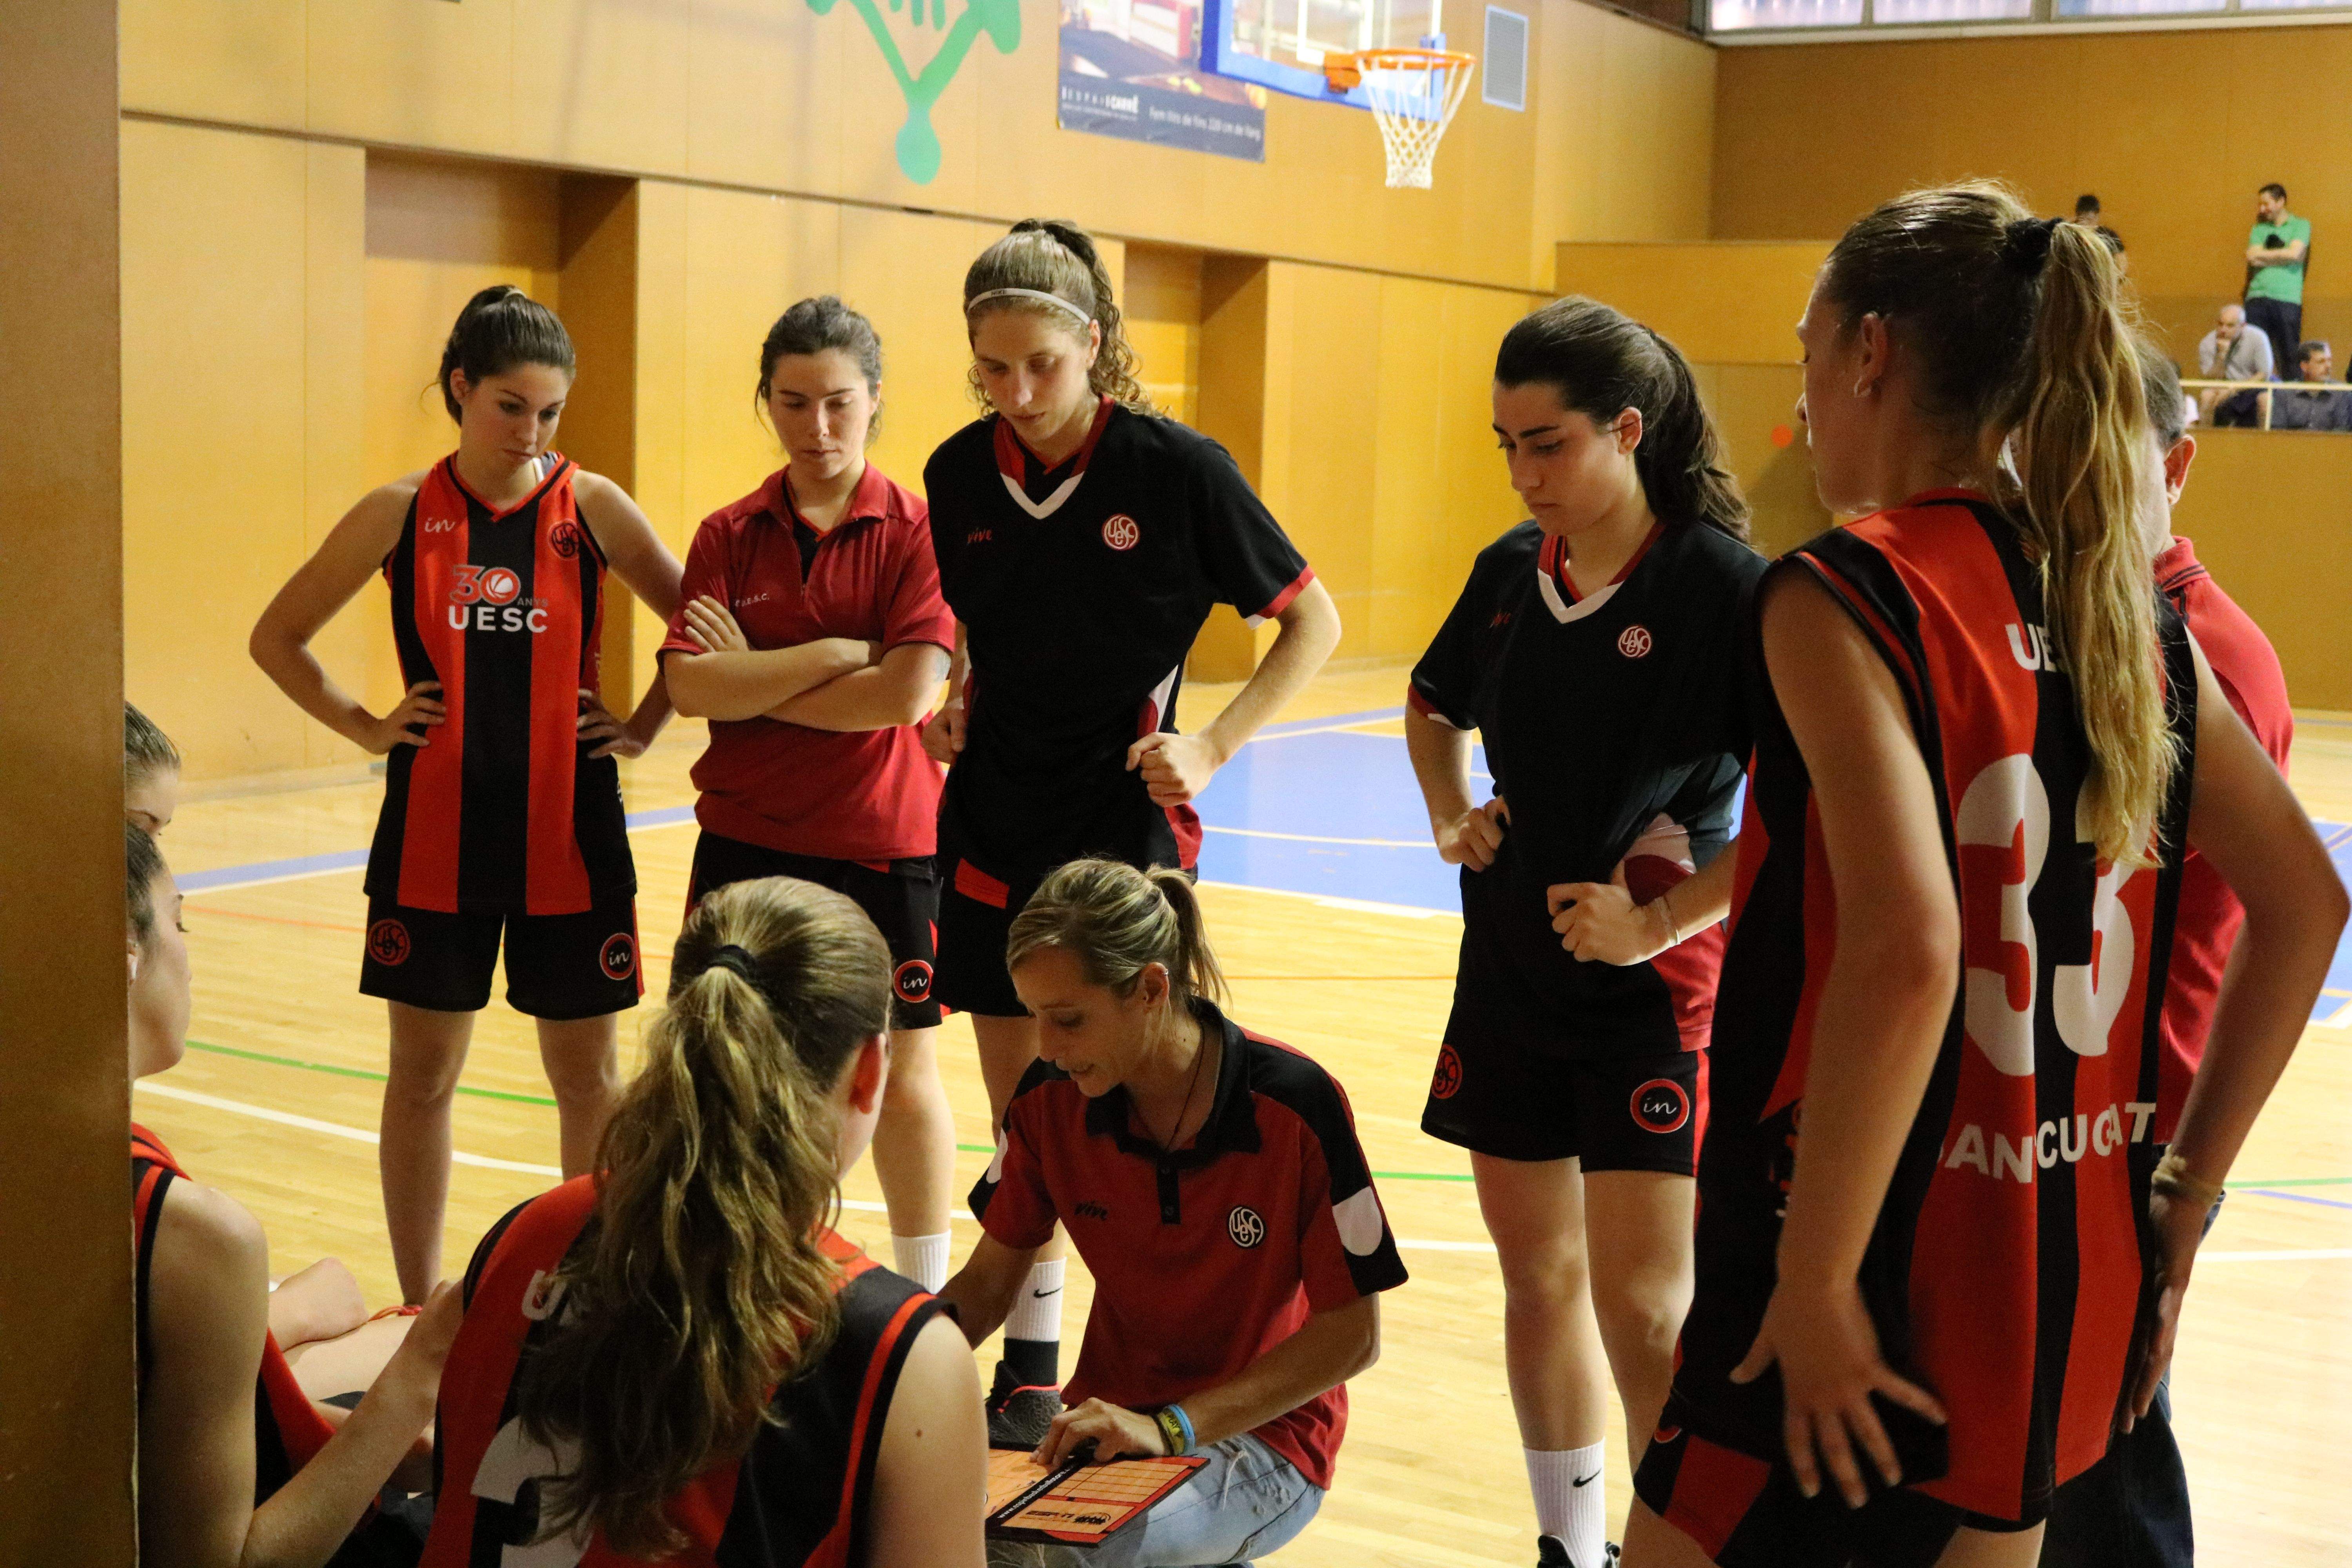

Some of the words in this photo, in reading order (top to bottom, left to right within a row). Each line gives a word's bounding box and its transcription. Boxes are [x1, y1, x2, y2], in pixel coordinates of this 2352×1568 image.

[424, 517, 455, 534] in
[448, 564, 521, 606] 30
[517, 597, 548, 608] ANYS
[448, 605, 548, 633] UESC
[608, 951, 630, 967] in
[903, 976, 927, 989] in
[1643, 1098, 1678, 1114] in
